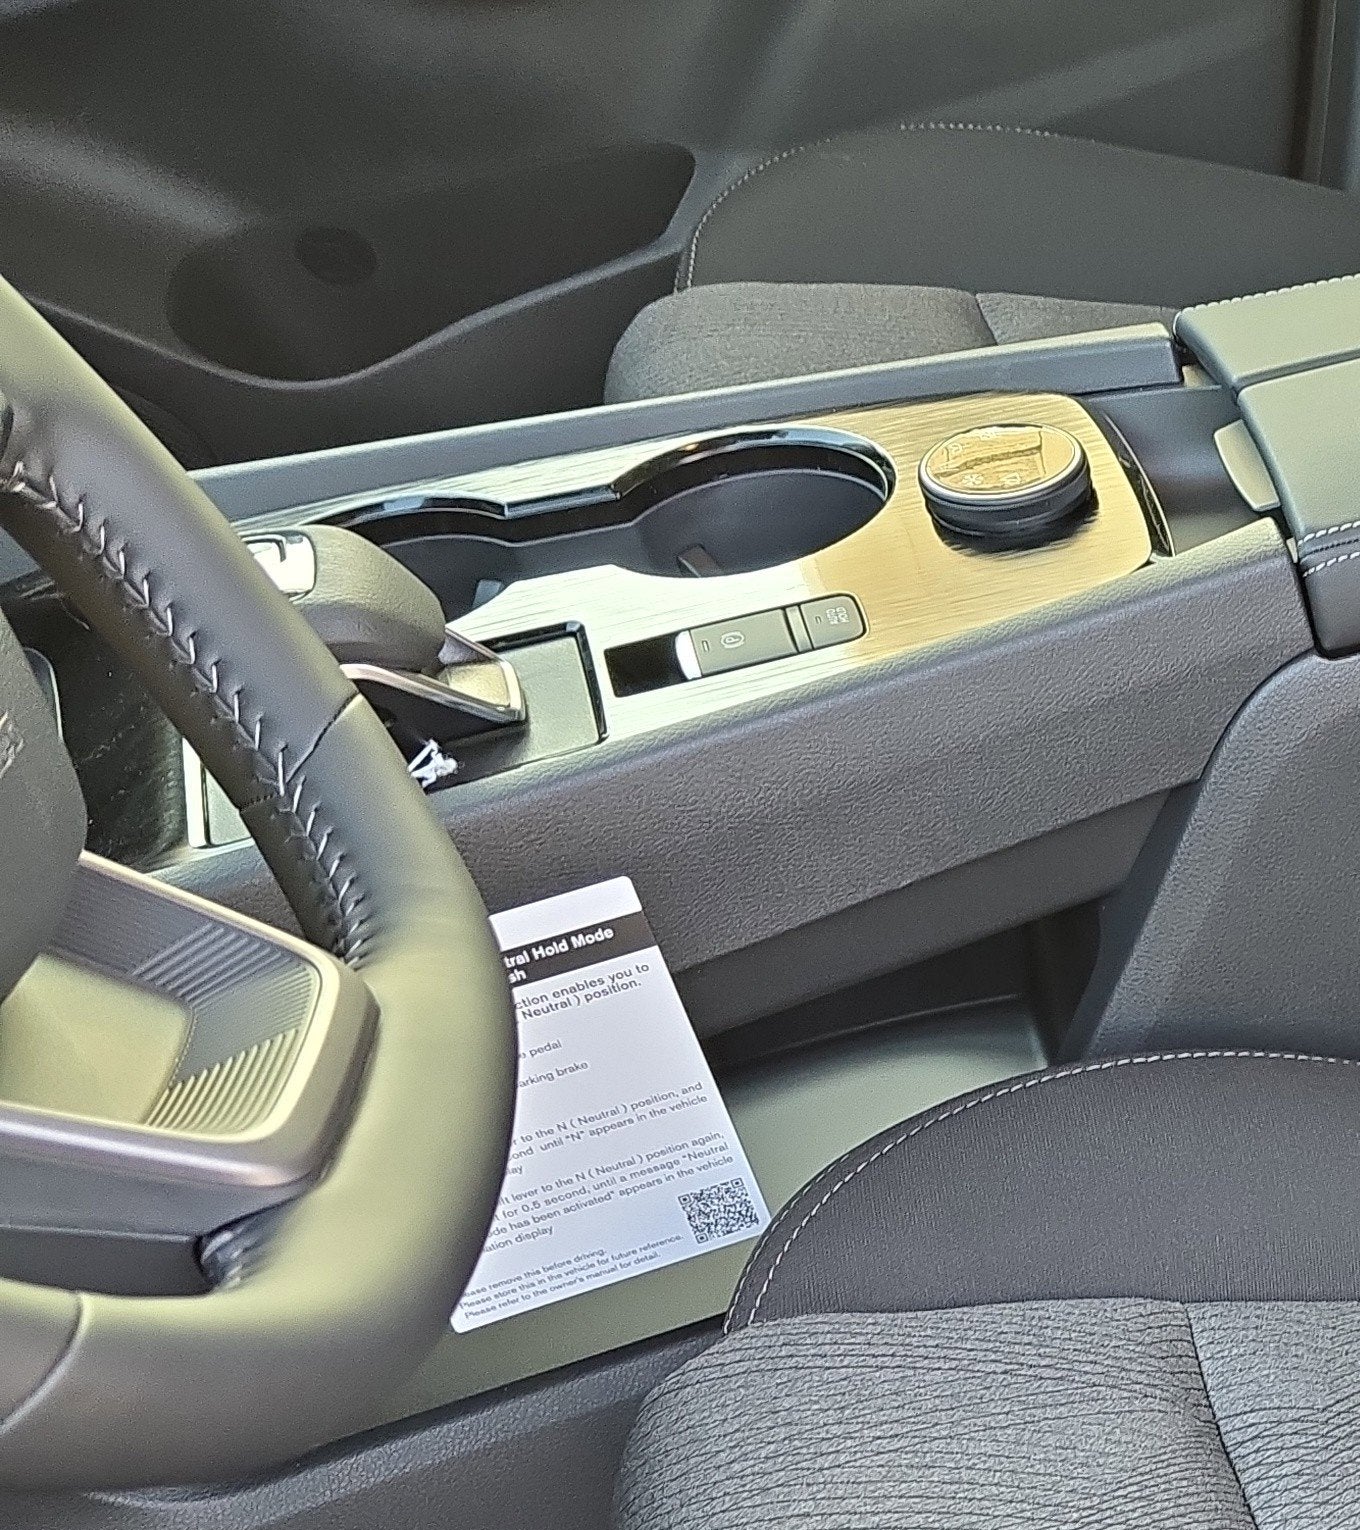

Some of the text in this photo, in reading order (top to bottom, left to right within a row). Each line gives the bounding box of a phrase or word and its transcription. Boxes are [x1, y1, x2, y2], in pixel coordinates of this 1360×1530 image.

[531, 938, 568, 960] Hold
[571, 925, 613, 950] Mode
[522, 997, 573, 1020] Neutral
[584, 980, 641, 1003] position.
[553, 962, 649, 999] enables you to
[529, 1039, 562, 1058] pedal
[555, 1059, 588, 1078] brake
[524, 1132, 532, 1143] to
[535, 1126, 553, 1140] the
[557, 1121, 565, 1133] N
[577, 1105, 620, 1126] Neutral
[630, 1088, 679, 1112] position,
[682, 1081, 702, 1095] and
[540, 1092, 707, 1152] until appears in the vehicle
[541, 1182, 551, 1194] to
[555, 1175, 573, 1189] the
[576, 1170, 585, 1183] N
[595, 1155, 636, 1176] Neutral
[646, 1142, 687, 1163] position
[691, 1129, 723, 1149] again,
[502, 1206, 519, 1220] for
[522, 1199, 540, 1213] 0.5
[593, 1176, 615, 1191] until
[619, 1174, 626, 1183] a
[509, 1154, 733, 1231] has been appears in the vehicle
[515, 1224, 552, 1245] display
